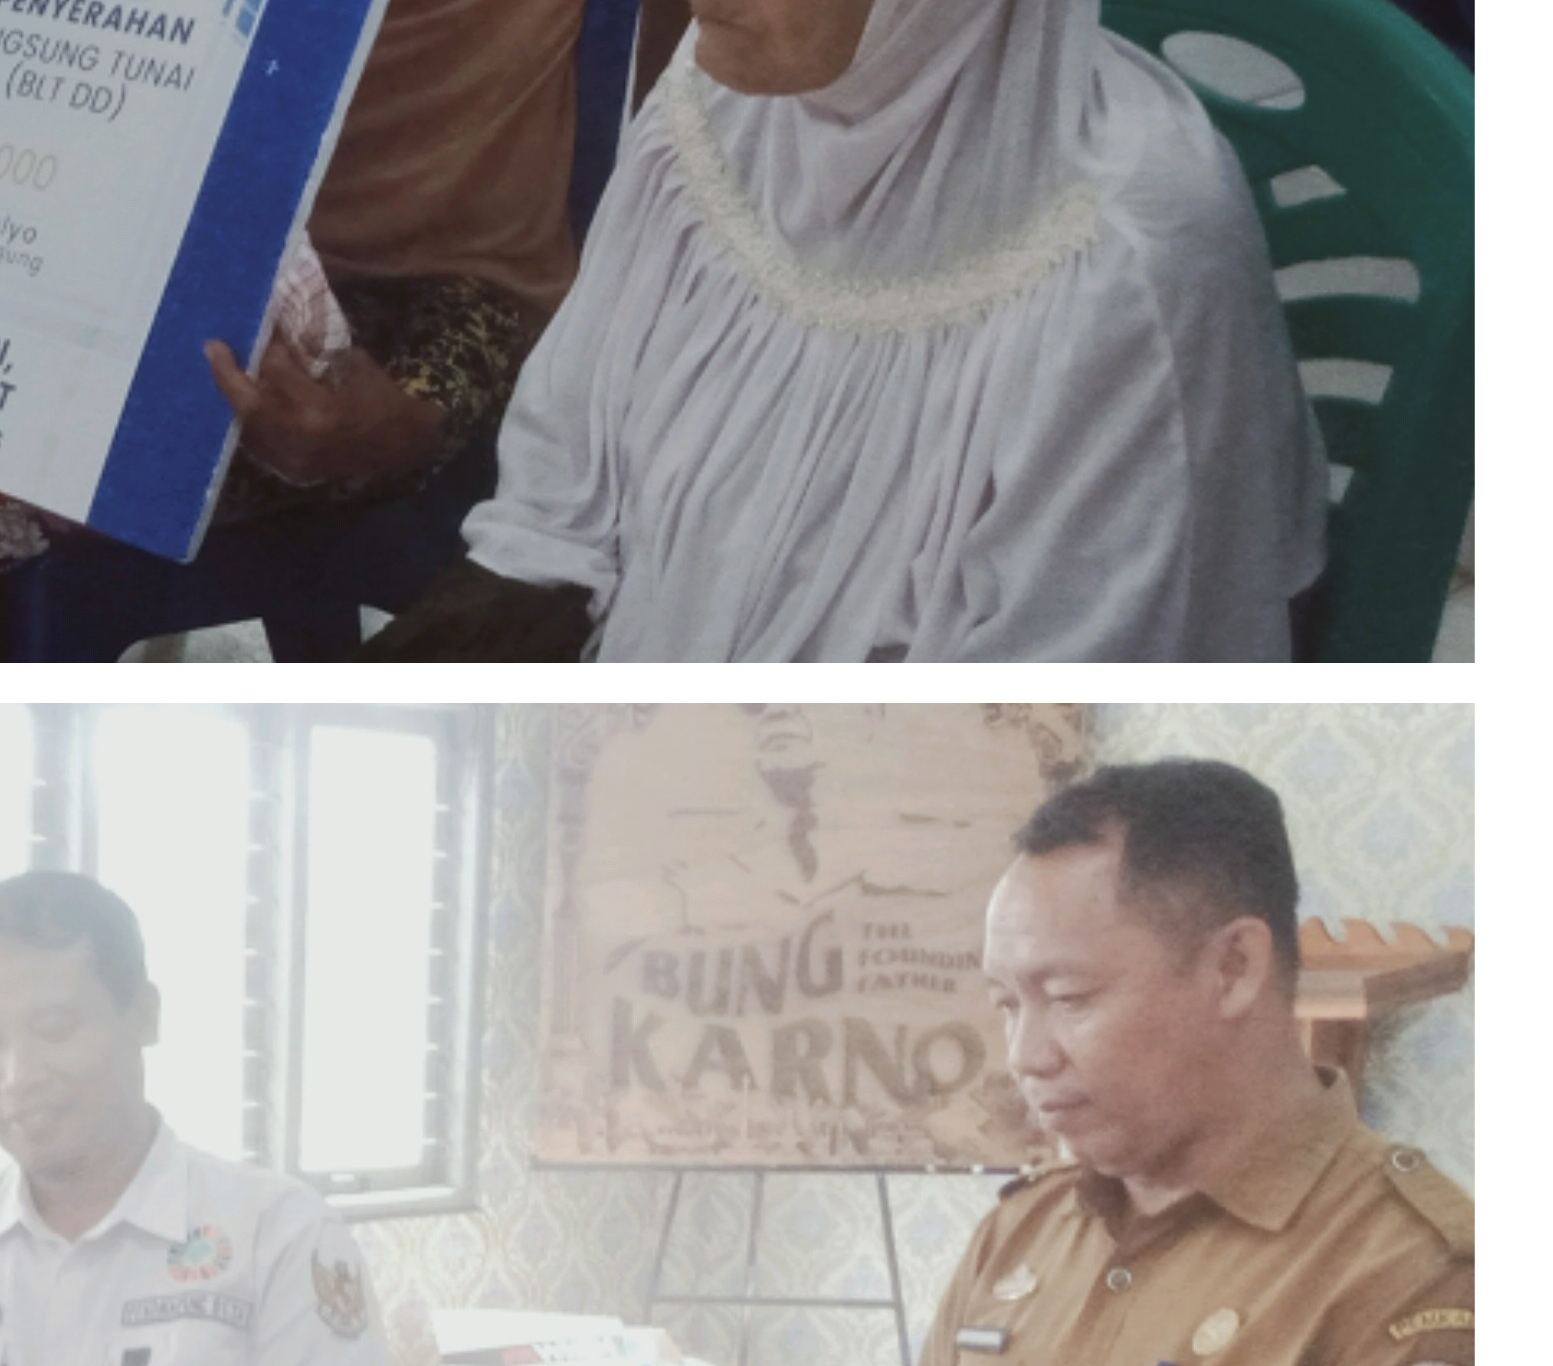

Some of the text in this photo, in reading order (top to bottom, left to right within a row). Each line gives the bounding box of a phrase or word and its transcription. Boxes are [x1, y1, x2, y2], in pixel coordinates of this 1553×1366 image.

[5, 60, 67, 103] (BLT
[68, 81, 128, 123] DD)
[110, 49, 197, 92] TUNAI
[640, 908, 844, 1017] BUNG
[858, 947, 983, 971] FOUNDIN
[608, 996, 987, 1110] KARNO
